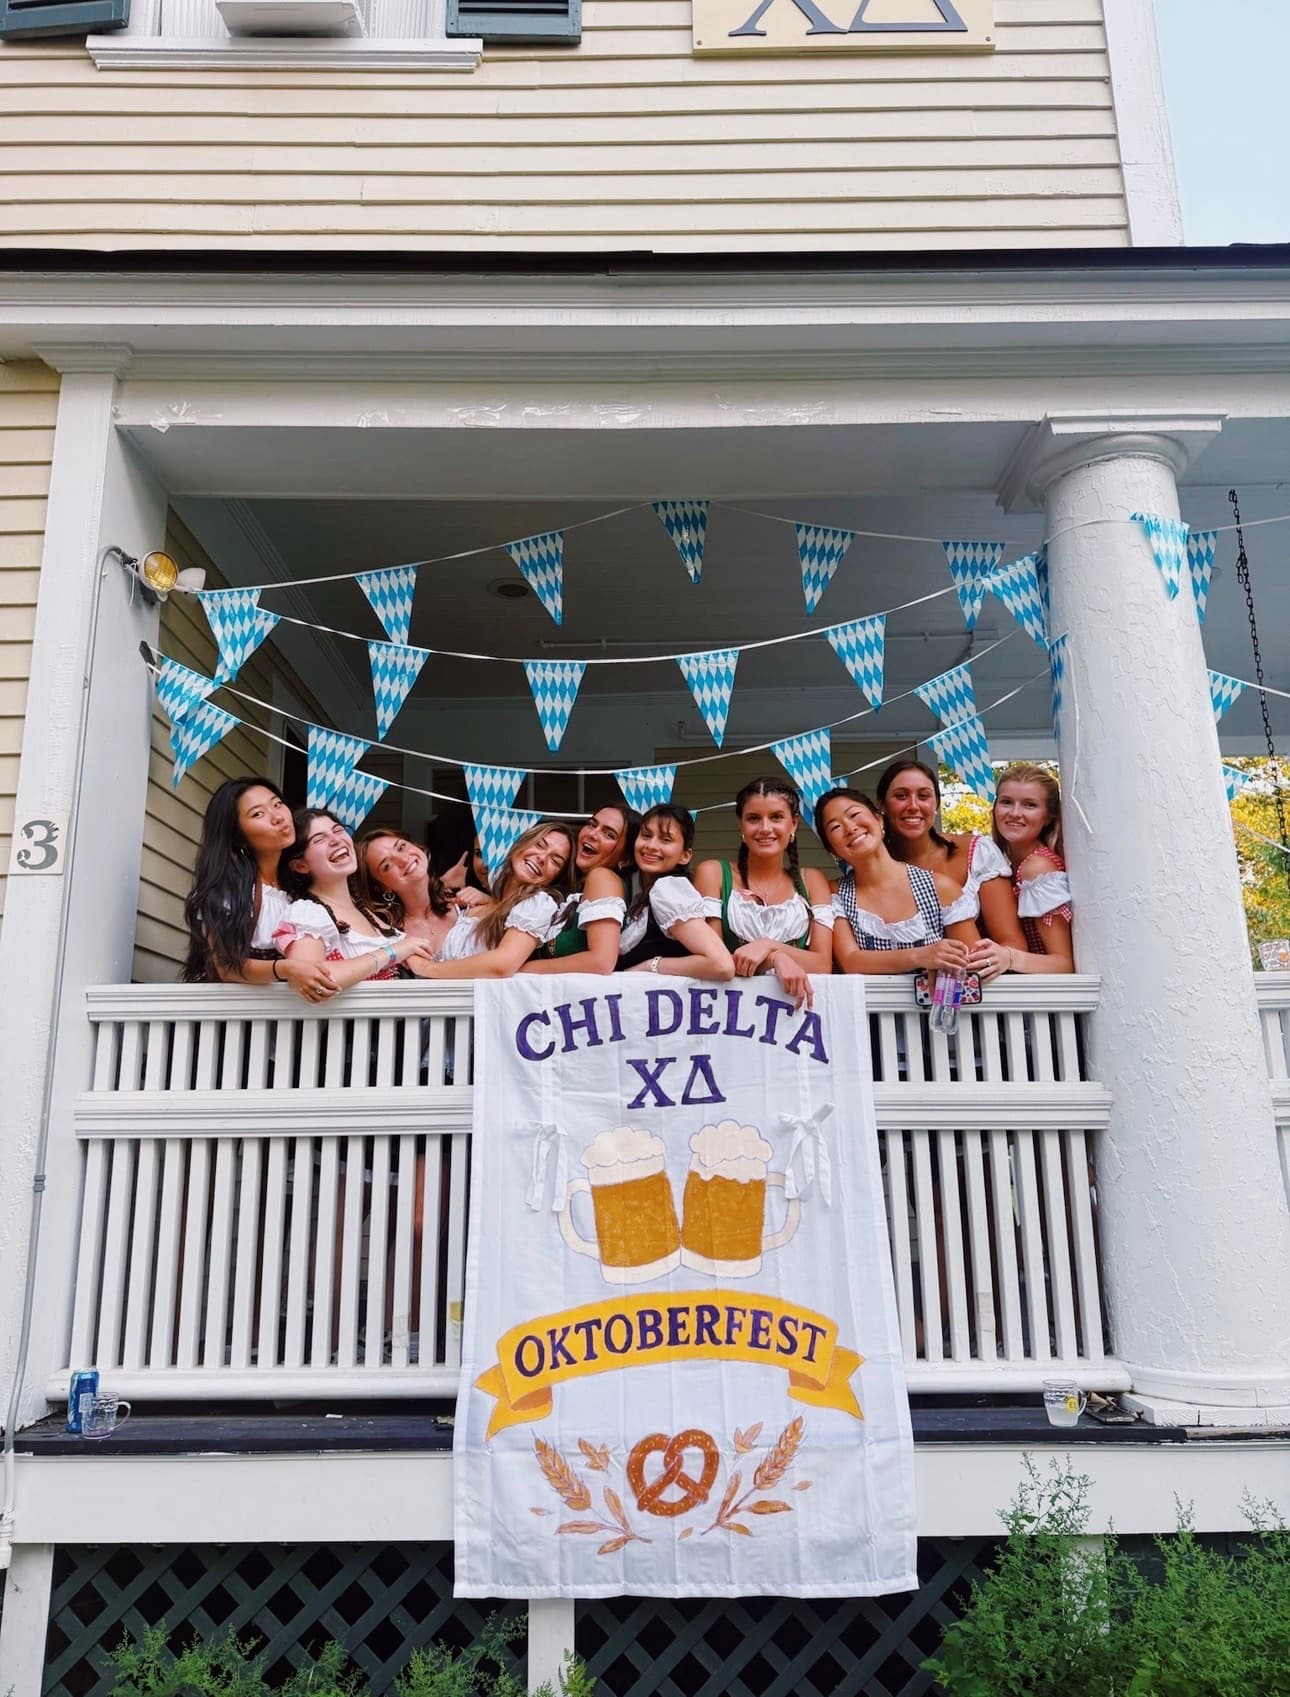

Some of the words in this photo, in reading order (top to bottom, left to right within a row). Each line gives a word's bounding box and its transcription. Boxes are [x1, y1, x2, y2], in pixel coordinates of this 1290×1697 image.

[16, 820, 59, 870] 3
[515, 993, 626, 1062] CHI
[645, 987, 830, 1065] DELTA
[514, 1304, 827, 1378] OKTOBERFEST
